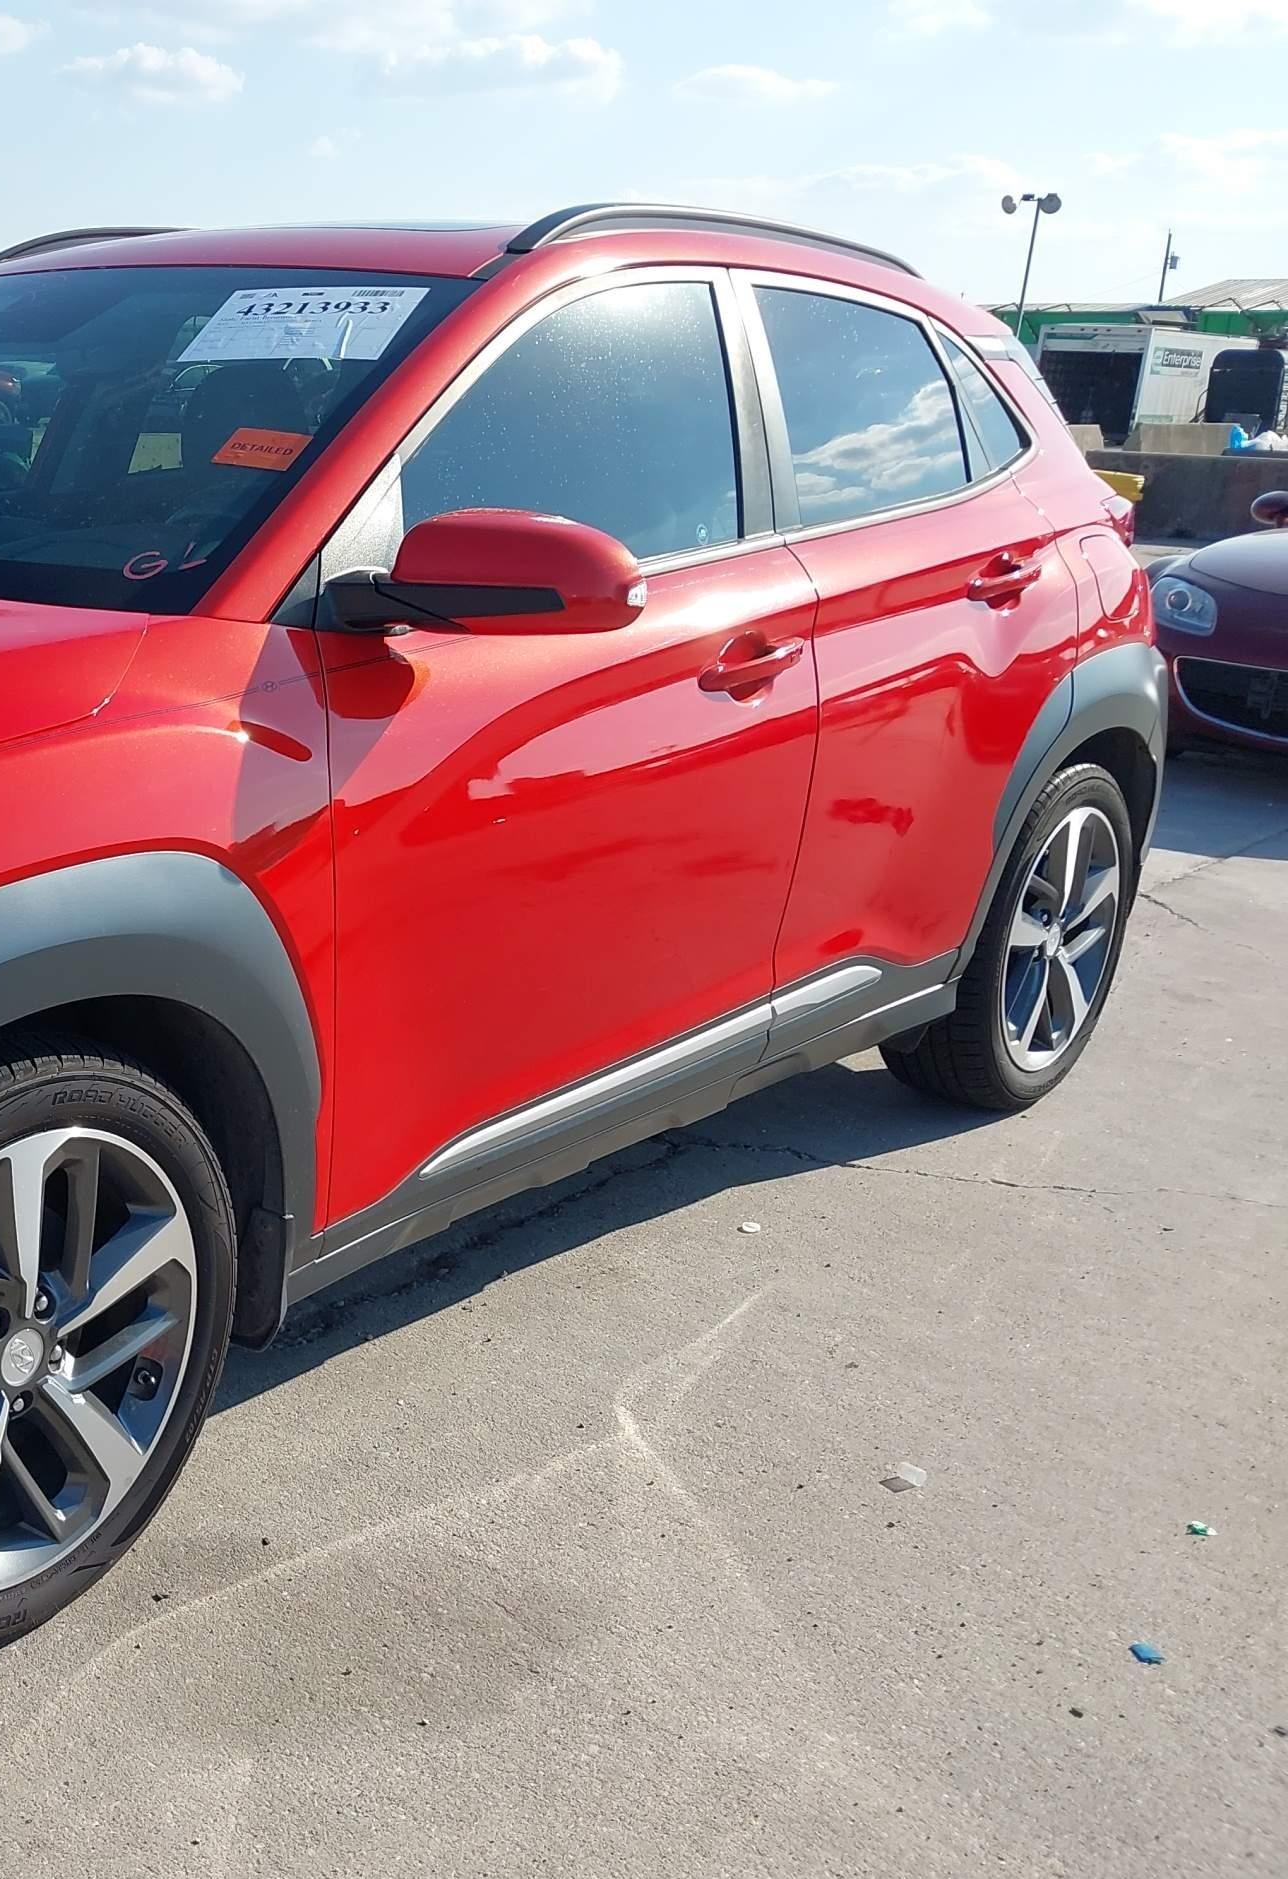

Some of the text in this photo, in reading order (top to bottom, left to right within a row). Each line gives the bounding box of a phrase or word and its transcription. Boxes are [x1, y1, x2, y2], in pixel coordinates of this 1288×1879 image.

[236, 301, 391, 316] 43213933
[1162, 350, 1202, 369] Enterprise
[231, 442, 294, 456] DETAILED
